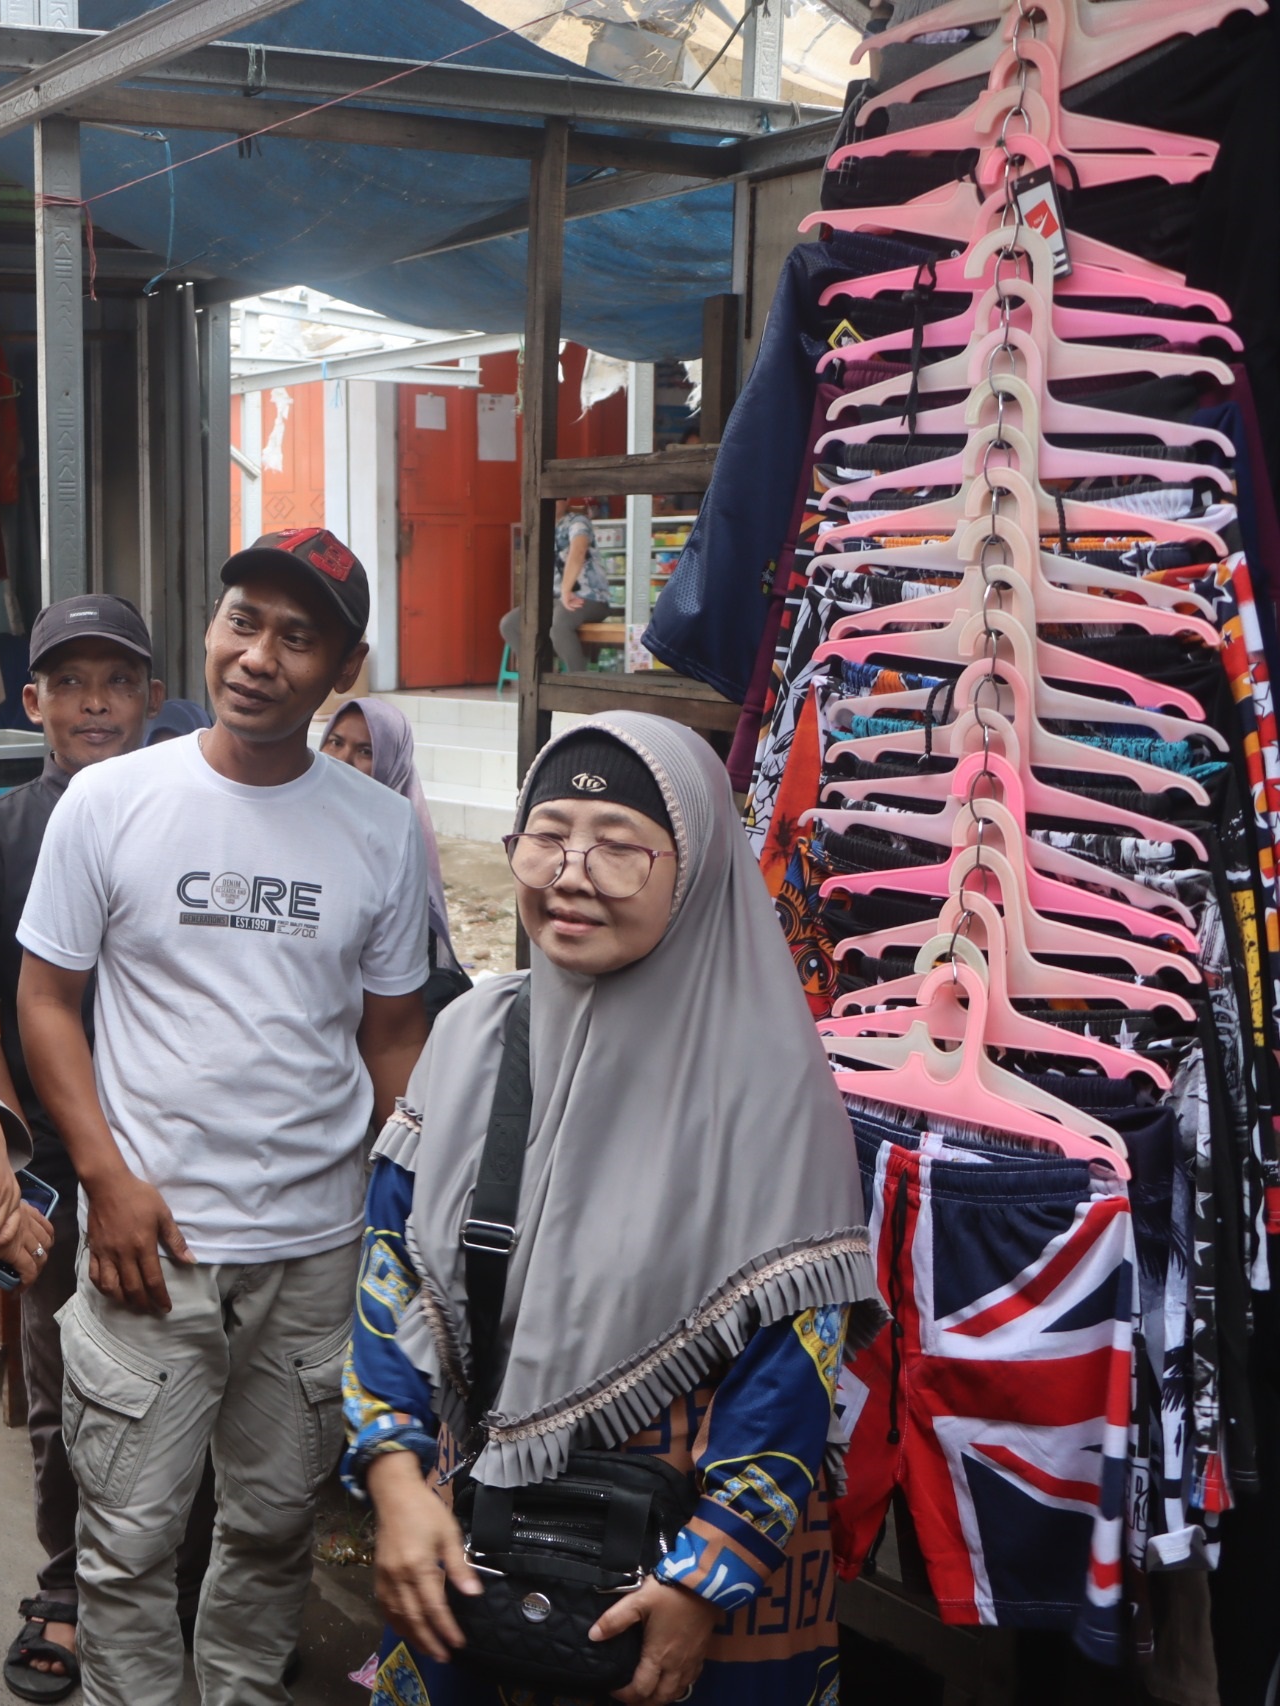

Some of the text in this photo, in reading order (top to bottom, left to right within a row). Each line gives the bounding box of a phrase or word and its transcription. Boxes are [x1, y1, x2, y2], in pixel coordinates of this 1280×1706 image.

[222, 878, 241, 888] DENIM
[176, 871, 322, 921] CORE
[183, 913, 226, 925] GENERATIONS
